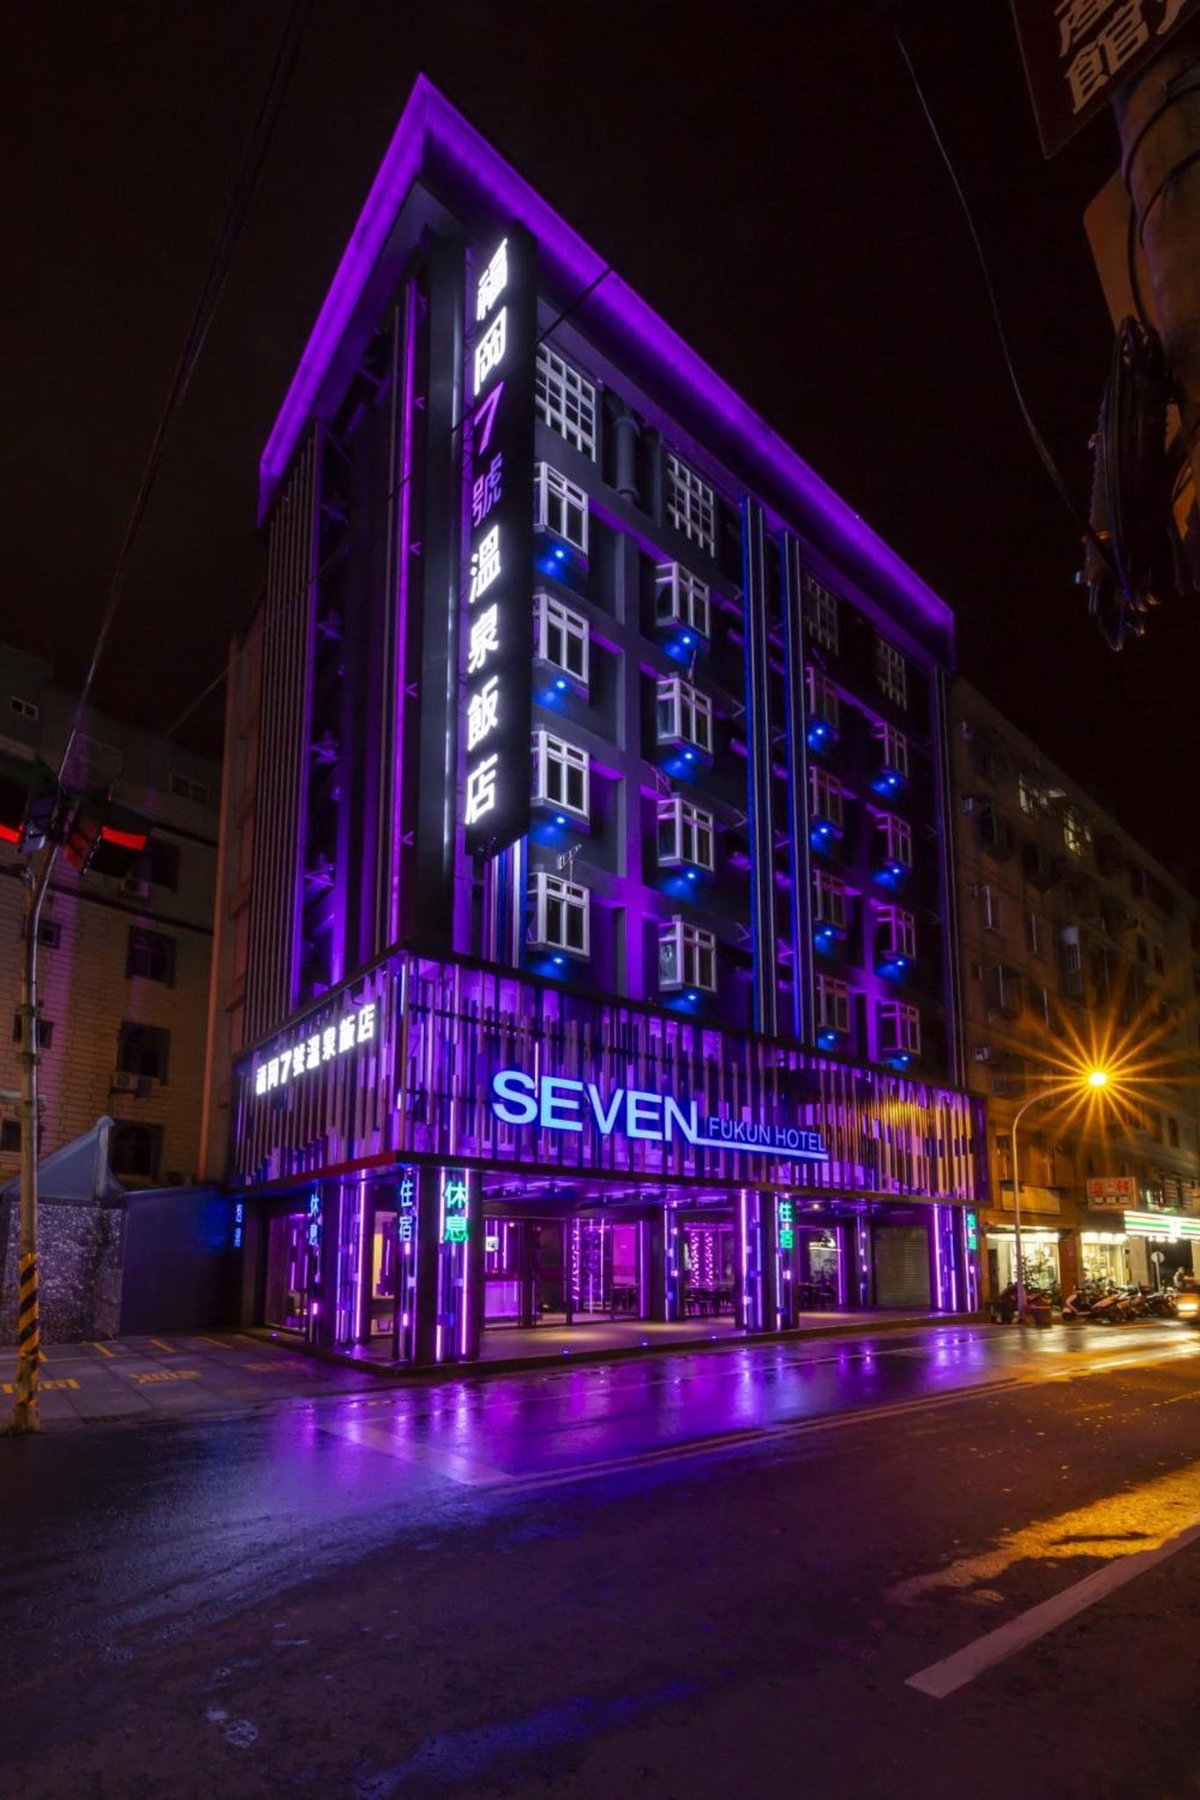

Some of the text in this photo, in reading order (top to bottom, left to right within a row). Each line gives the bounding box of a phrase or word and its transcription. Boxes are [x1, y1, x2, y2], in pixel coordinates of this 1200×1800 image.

[491, 1069, 826, 1152] SEVEN FUKUN HOTEL
[398, 1179, 414, 1243] 住宿
[443, 1181, 470, 1243] 休息
